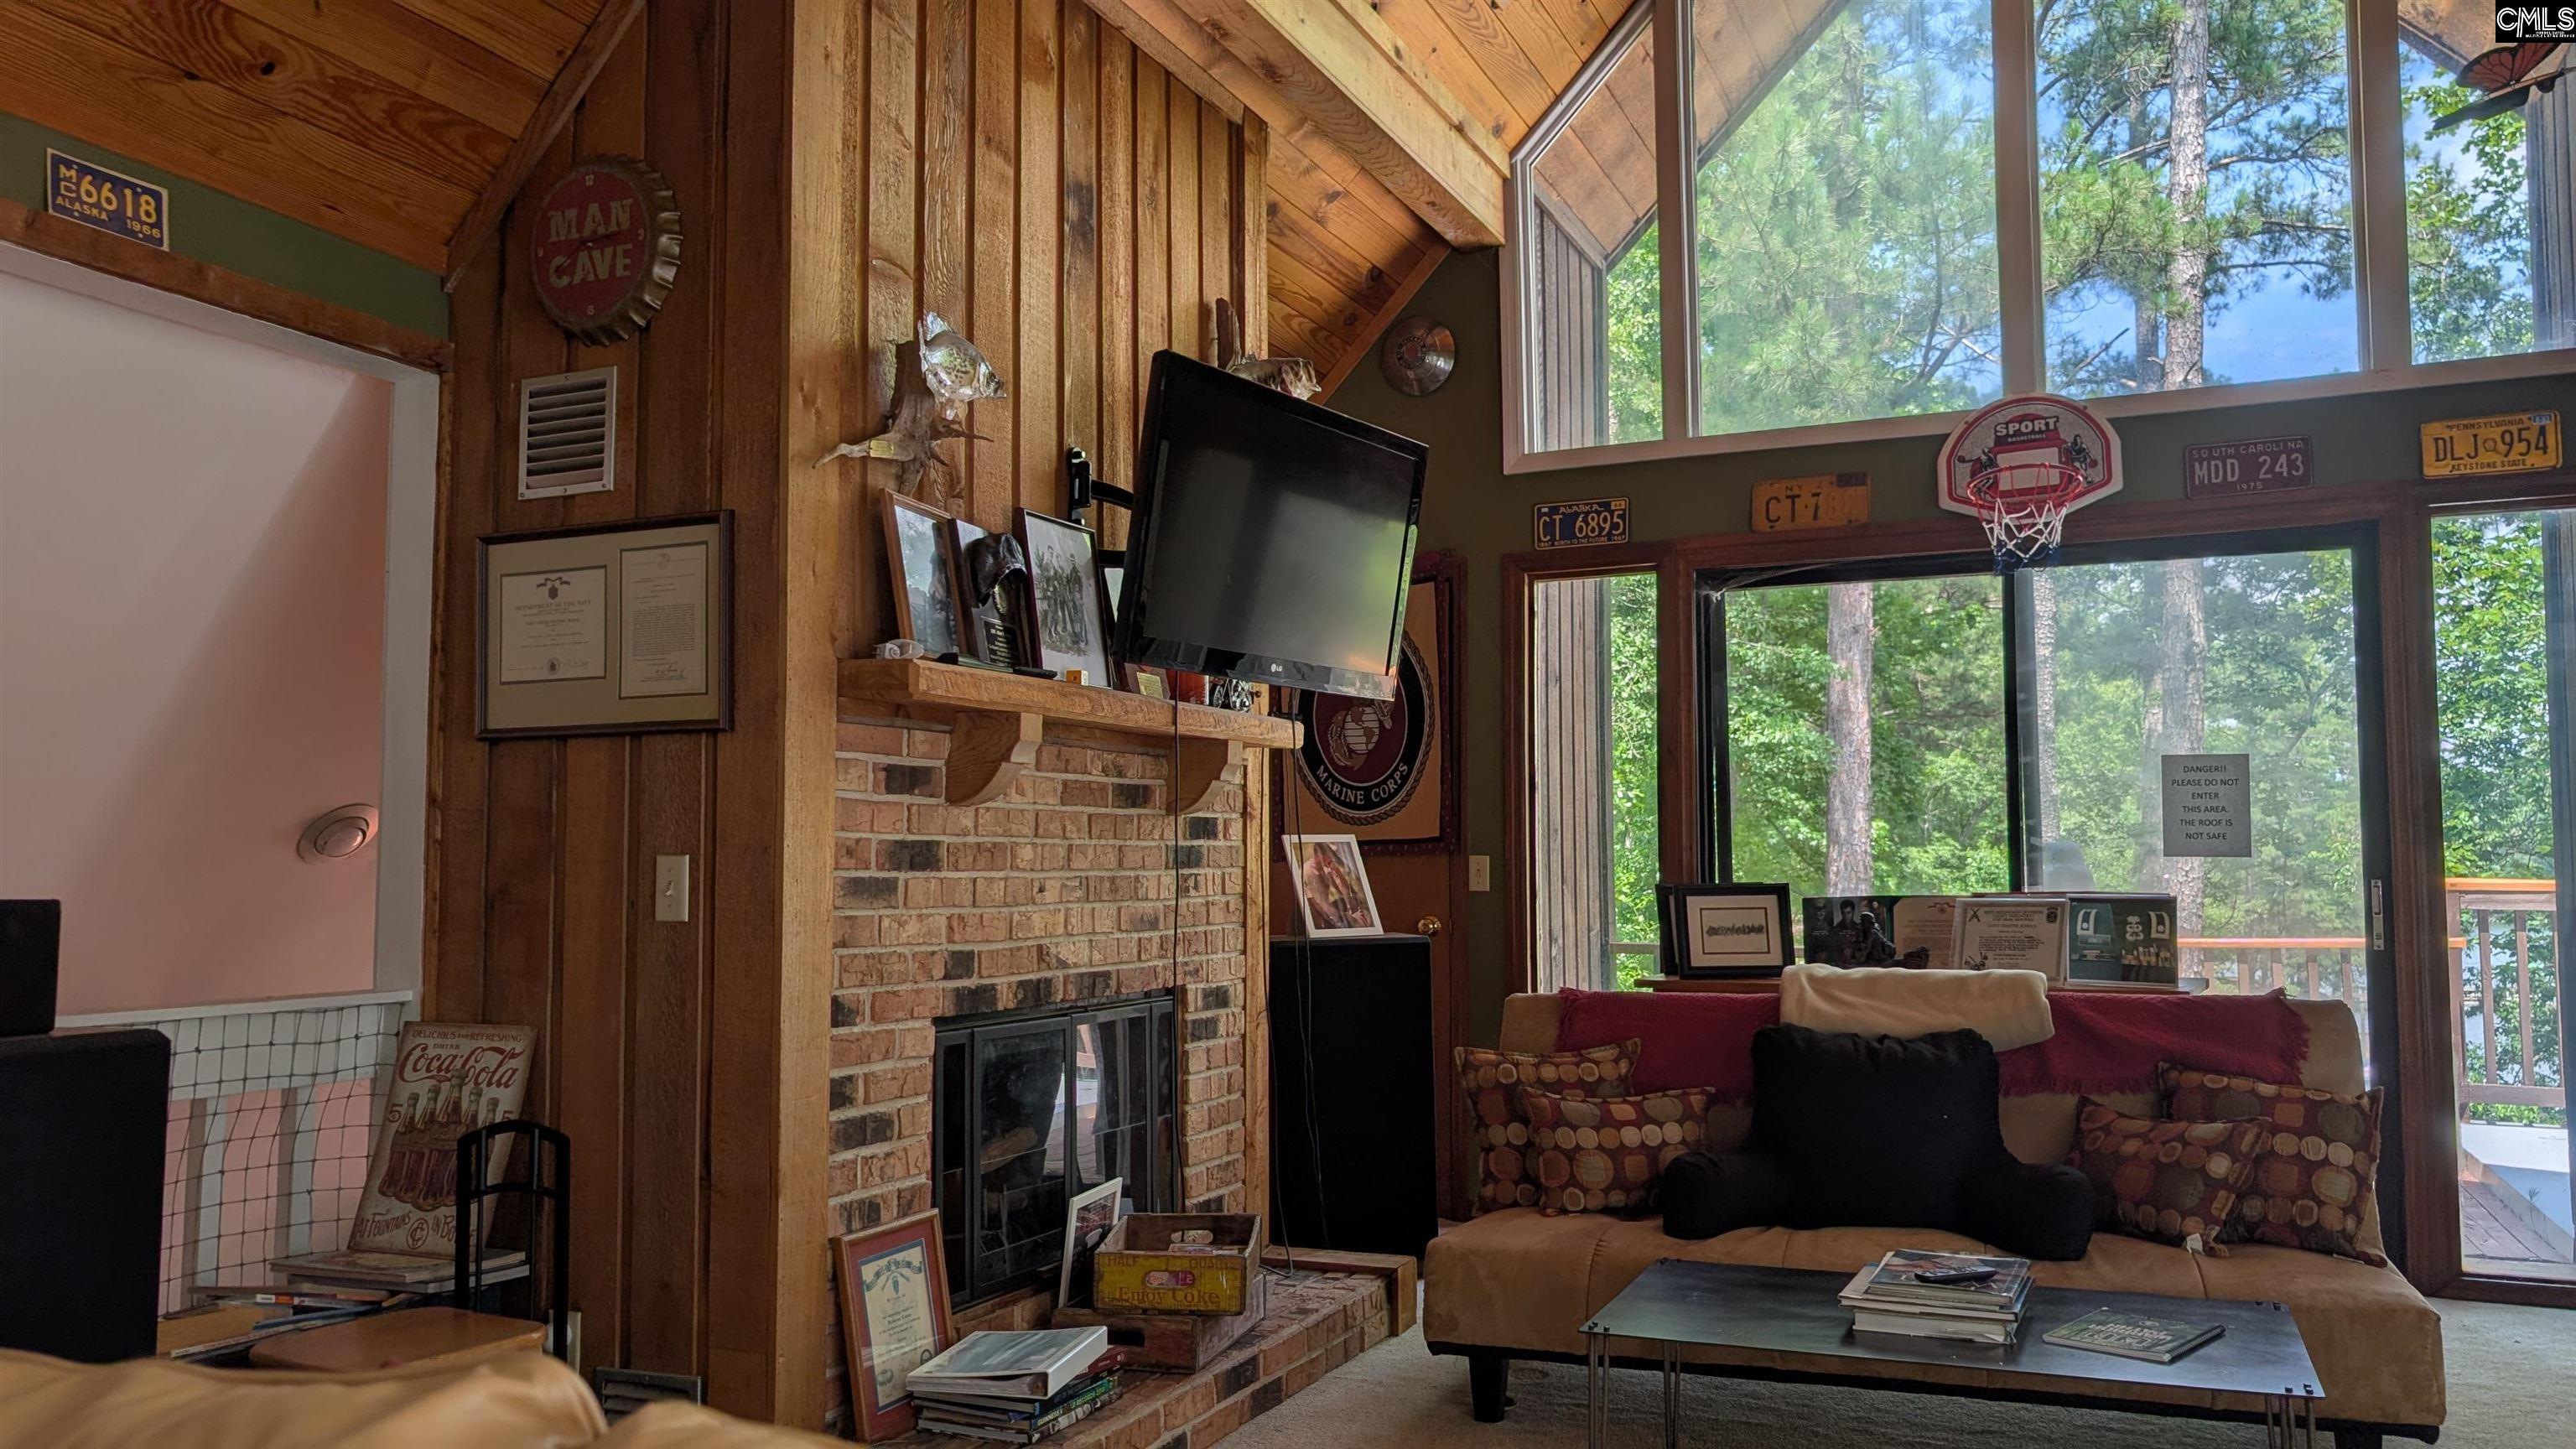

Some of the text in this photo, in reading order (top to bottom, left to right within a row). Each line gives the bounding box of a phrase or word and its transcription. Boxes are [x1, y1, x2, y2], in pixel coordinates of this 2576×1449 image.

[80, 174, 158, 224] 6618
[55, 195, 109, 222] ALASKA
[548, 198, 633, 242] MAN
[126, 218, 161, 239] 1966
[549, 243, 632, 288] CAVE
[1995, 417, 2058, 436] SPORT
[2447, 418, 2525, 431] PENNSYLVANIA
[2007, 434, 2046, 443] BASKETBALL
[2433, 425, 2548, 462] DLJ 954
[2192, 440, 2304, 458] SOUTH CAROLINA
[2194, 453, 2304, 485] MDD 243
[2449, 459, 2527, 473] KEYSTONE STATE
[2236, 481, 2263, 491] 1975
[1559, 503, 1604, 514] ALASKA
[1539, 510, 1624, 542] CT 6895
[2183, 765, 2226, 773] DANGER!!
[1317, 762, 1409, 805] MARINE CORPS
[2171, 778, 2239, 787] PLEASE DO NOT
[2191, 792, 2220, 800] ENTER
[2182, 805, 2229, 813] THIS AREA.
[2179, 818, 2233, 827] THE ROOF IS
[2185, 832, 2228, 840] NOT SAFE
[412, 1029, 457, 1040] DELICIOUS
[470, 1032, 522, 1043] REFRESHING
[1107, 1255, 1140, 1267] HALF
[1118, 1286, 1220, 1306] Enjoy Coke
